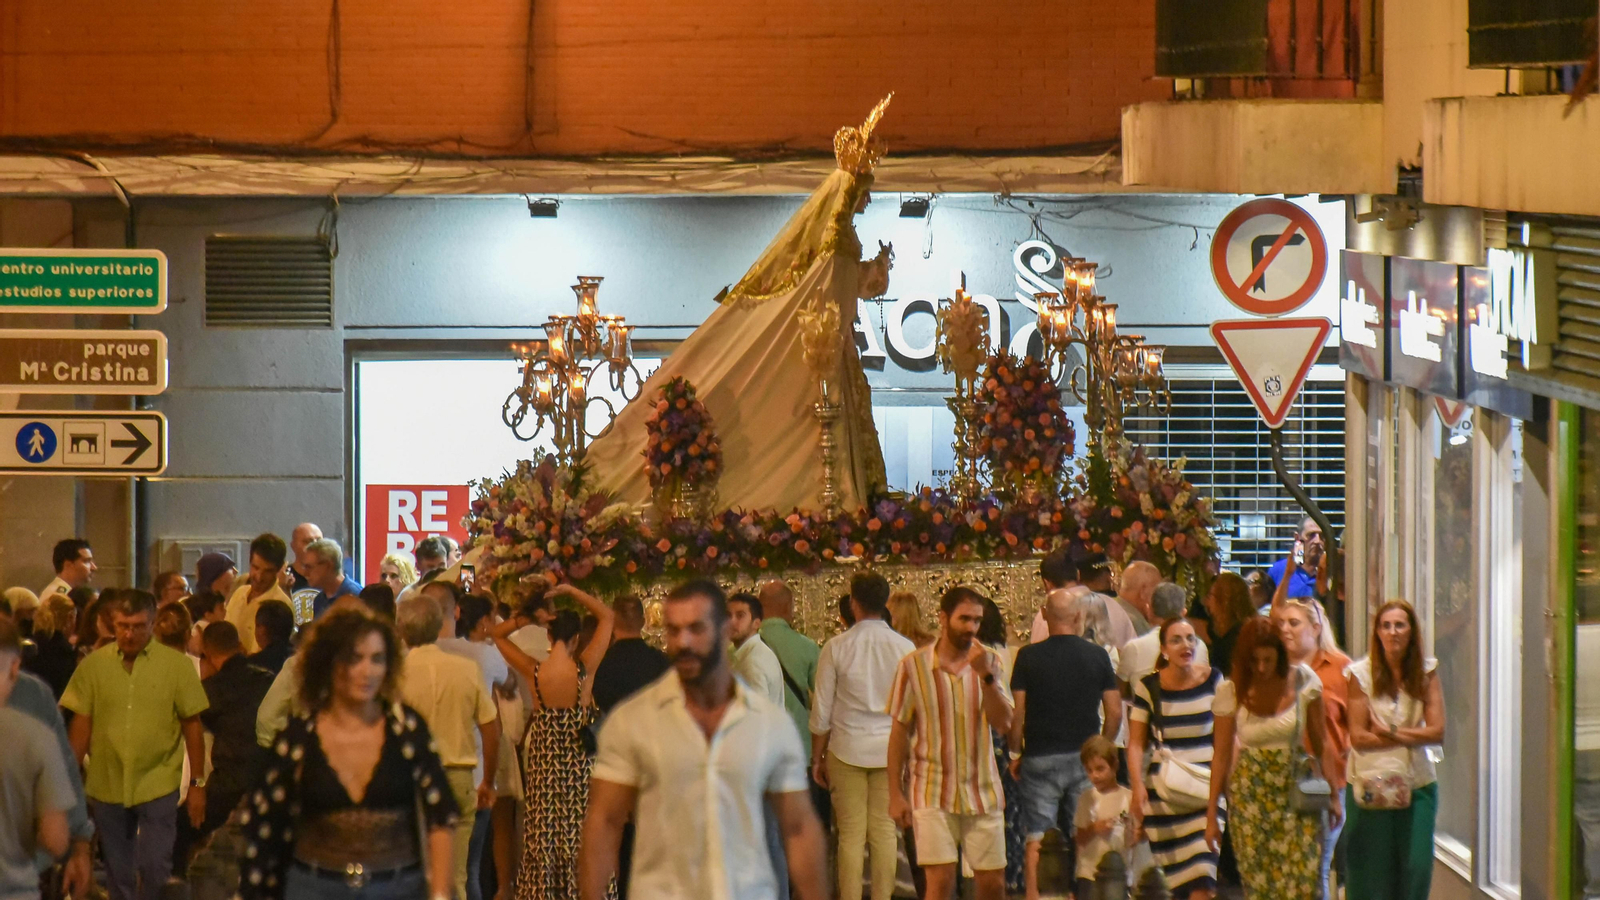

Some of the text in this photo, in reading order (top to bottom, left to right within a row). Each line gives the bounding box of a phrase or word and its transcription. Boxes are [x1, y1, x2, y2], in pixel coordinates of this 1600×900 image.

[0, 262, 153, 275] entro universitario
[69, 286, 153, 300] superiores
[84, 343, 150, 359] parque
[53, 361, 149, 381] Cristina
[388, 490, 449, 532] RE
